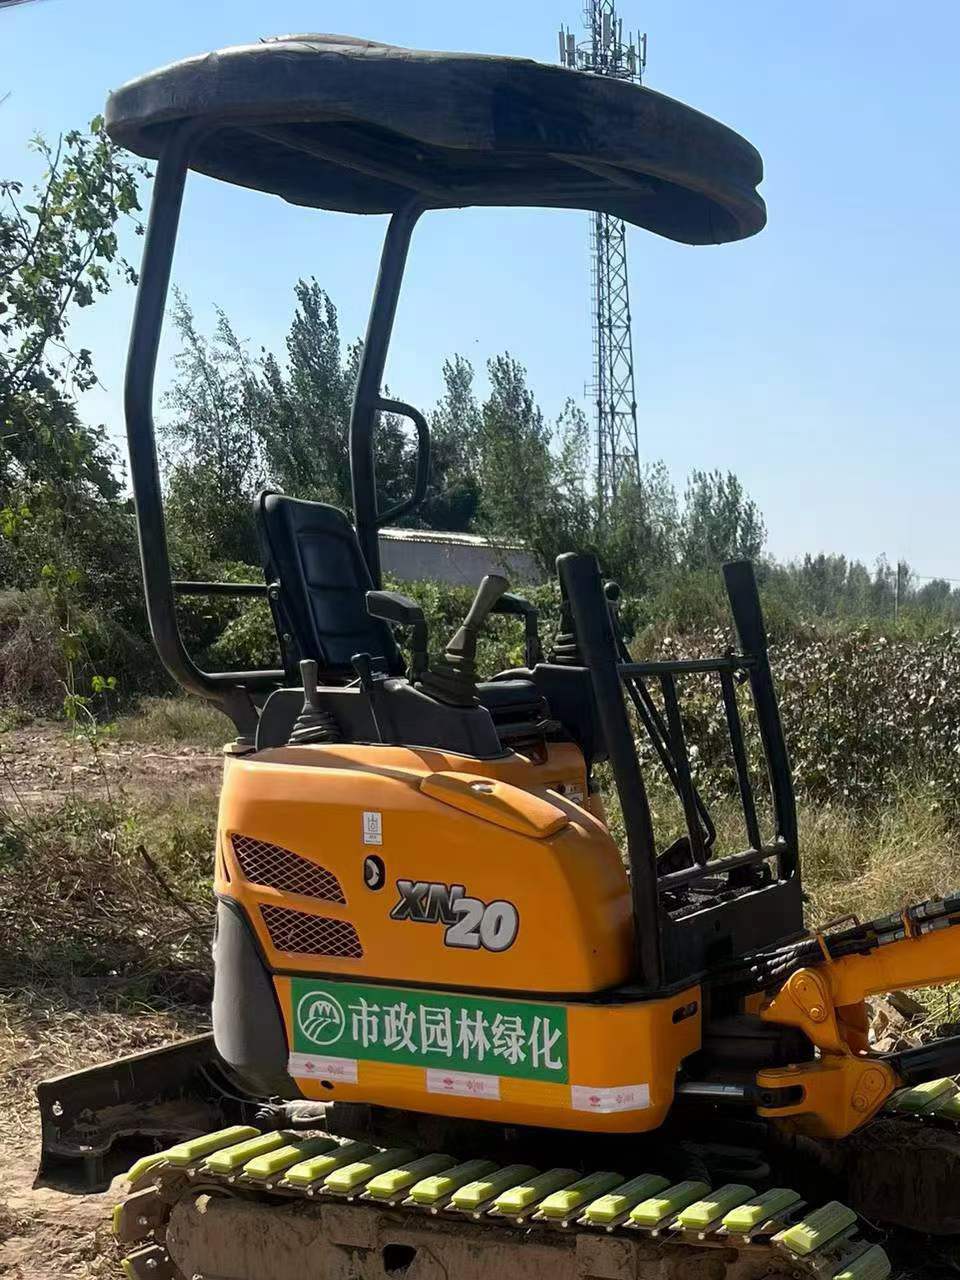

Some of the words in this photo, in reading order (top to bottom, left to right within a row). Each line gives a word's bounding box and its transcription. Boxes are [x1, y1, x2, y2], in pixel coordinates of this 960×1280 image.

[390, 879, 520, 953] XN20
[349, 997, 564, 1070] 市政园林绿化
